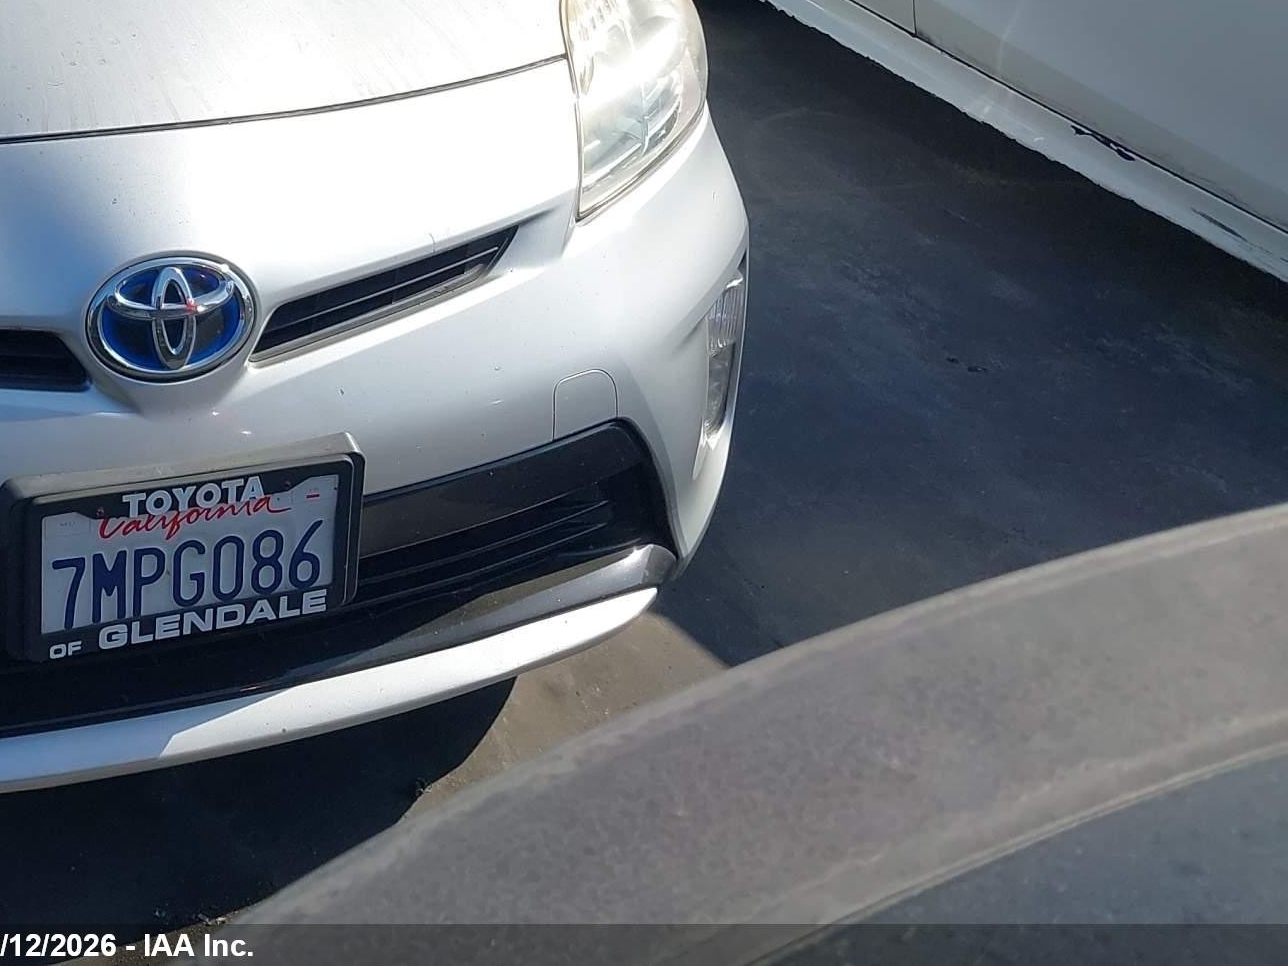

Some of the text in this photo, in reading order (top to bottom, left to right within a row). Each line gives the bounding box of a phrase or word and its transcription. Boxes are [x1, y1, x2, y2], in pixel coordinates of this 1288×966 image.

[96, 494, 292, 540] California
[121, 475, 267, 519] TOYOTA
[51, 519, 324, 630] 7MPG086
[49, 588, 328, 660] OF GLENDALE
